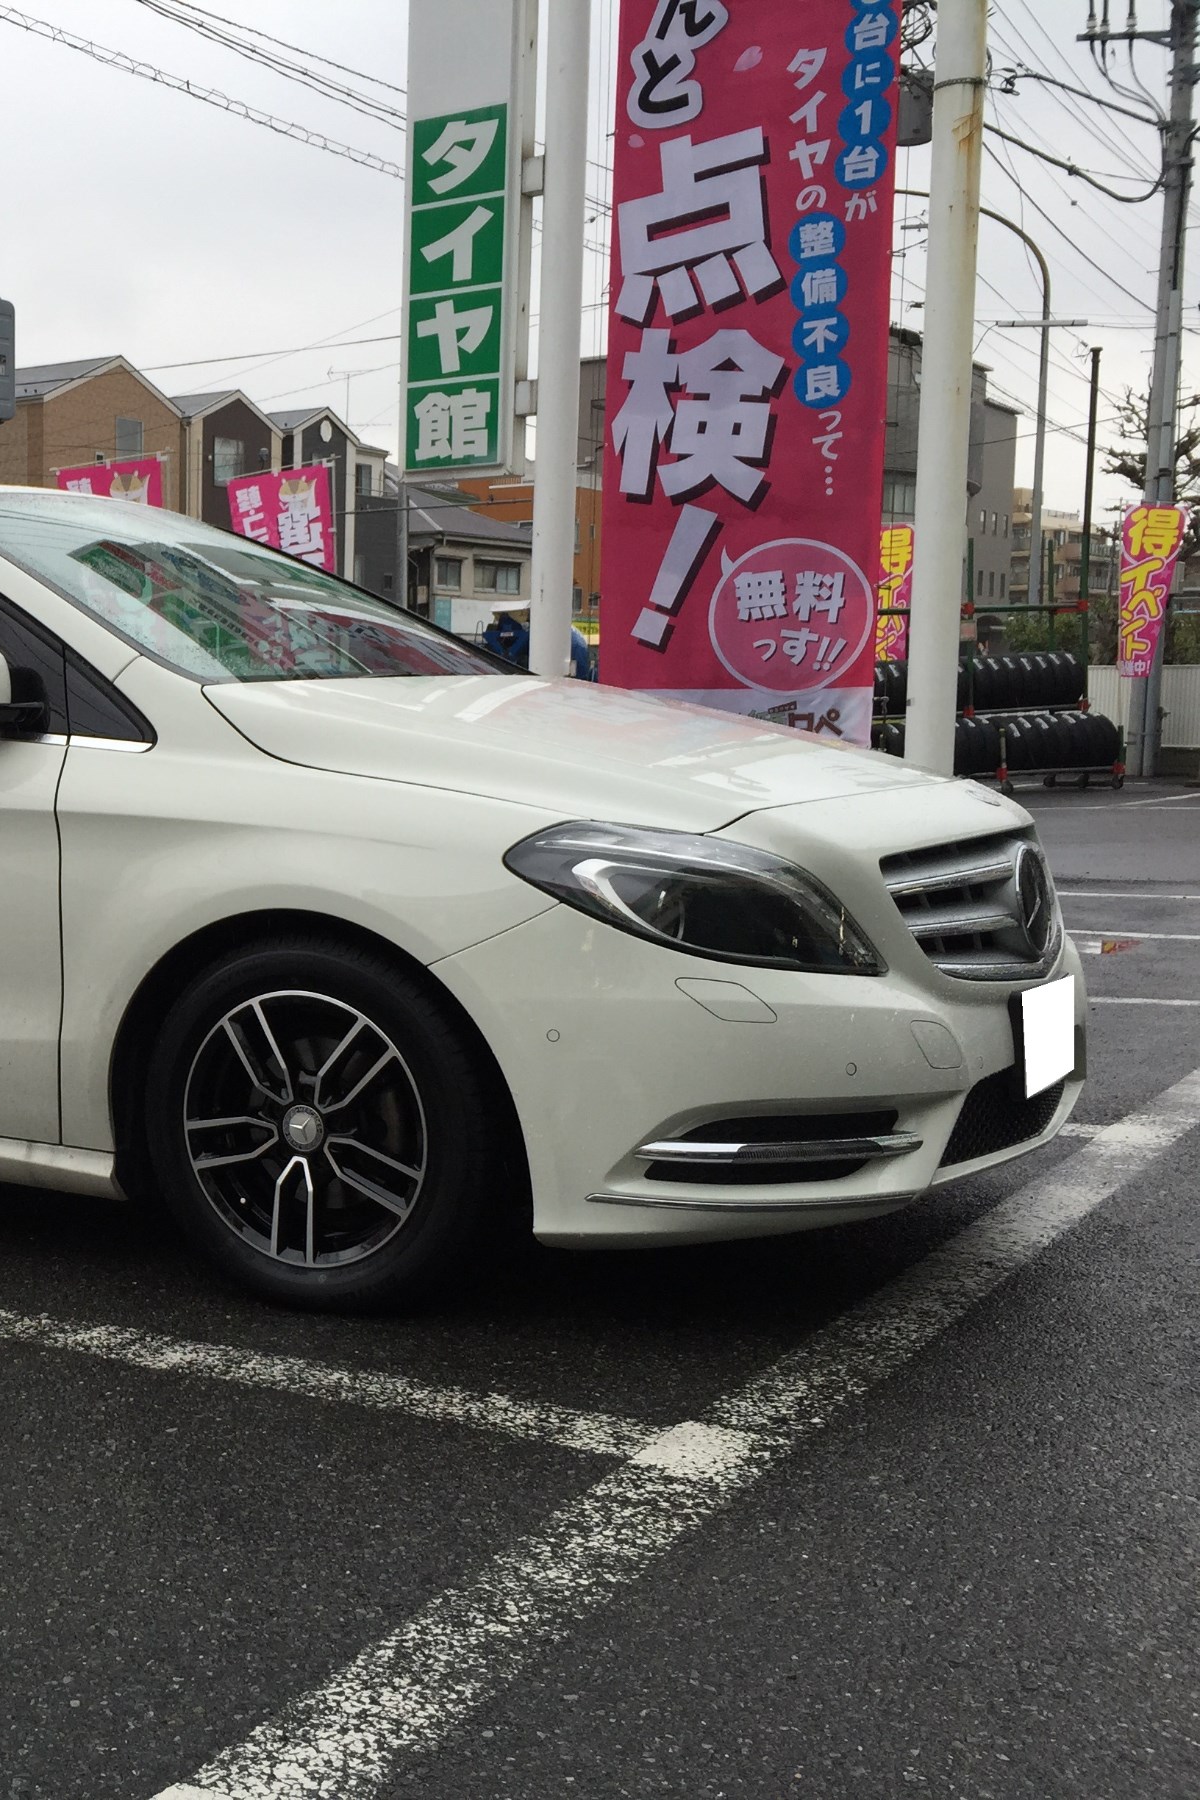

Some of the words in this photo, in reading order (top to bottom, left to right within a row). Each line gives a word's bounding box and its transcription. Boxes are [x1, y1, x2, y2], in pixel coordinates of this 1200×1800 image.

[843, 0, 890, 221] 台に1台が
[413, 117, 500, 461] タイヤ館
[734, 570, 845, 623] 無料
